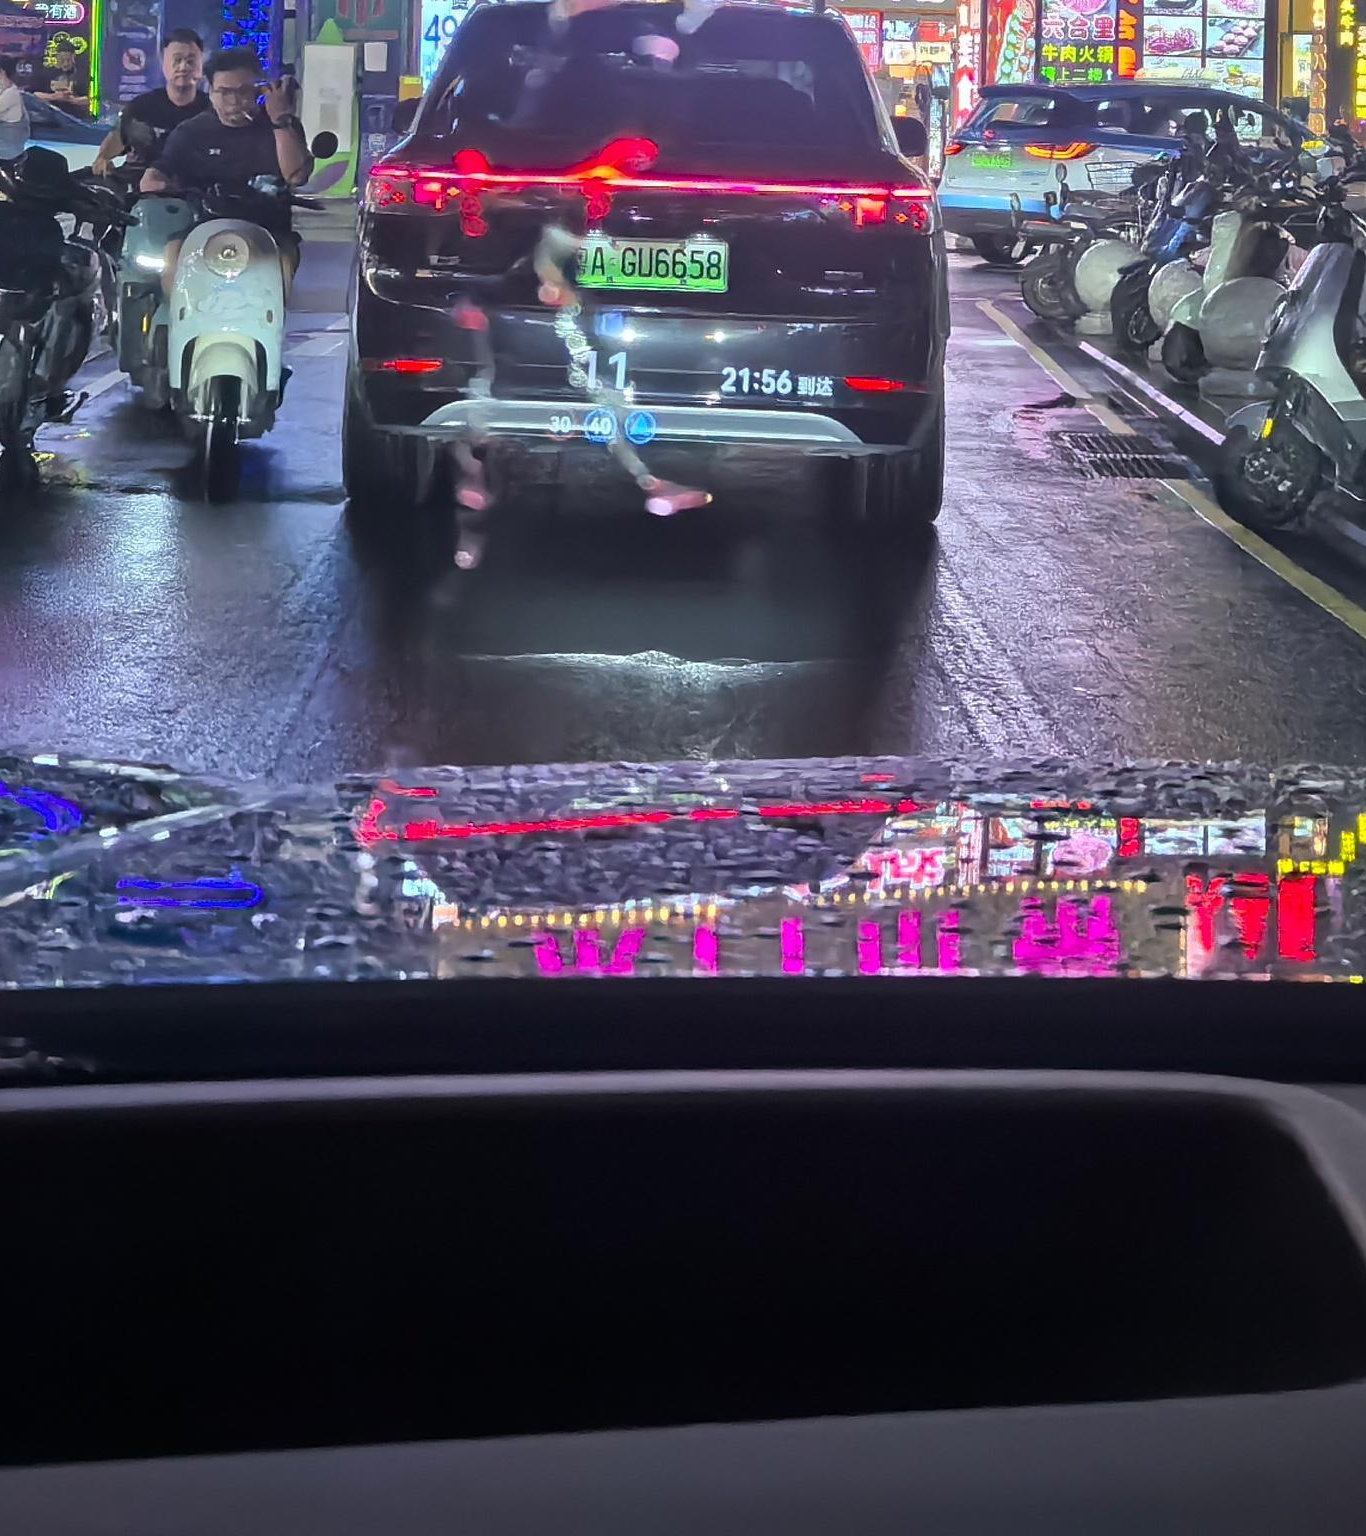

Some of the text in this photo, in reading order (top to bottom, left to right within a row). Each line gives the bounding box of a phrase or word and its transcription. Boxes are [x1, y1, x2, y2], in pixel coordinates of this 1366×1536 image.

[1041, 12, 1116, 40] 六合里
[1041, 43, 1115, 63] 牛肉火锅
[720, 367, 834, 396] 21:56 到达
